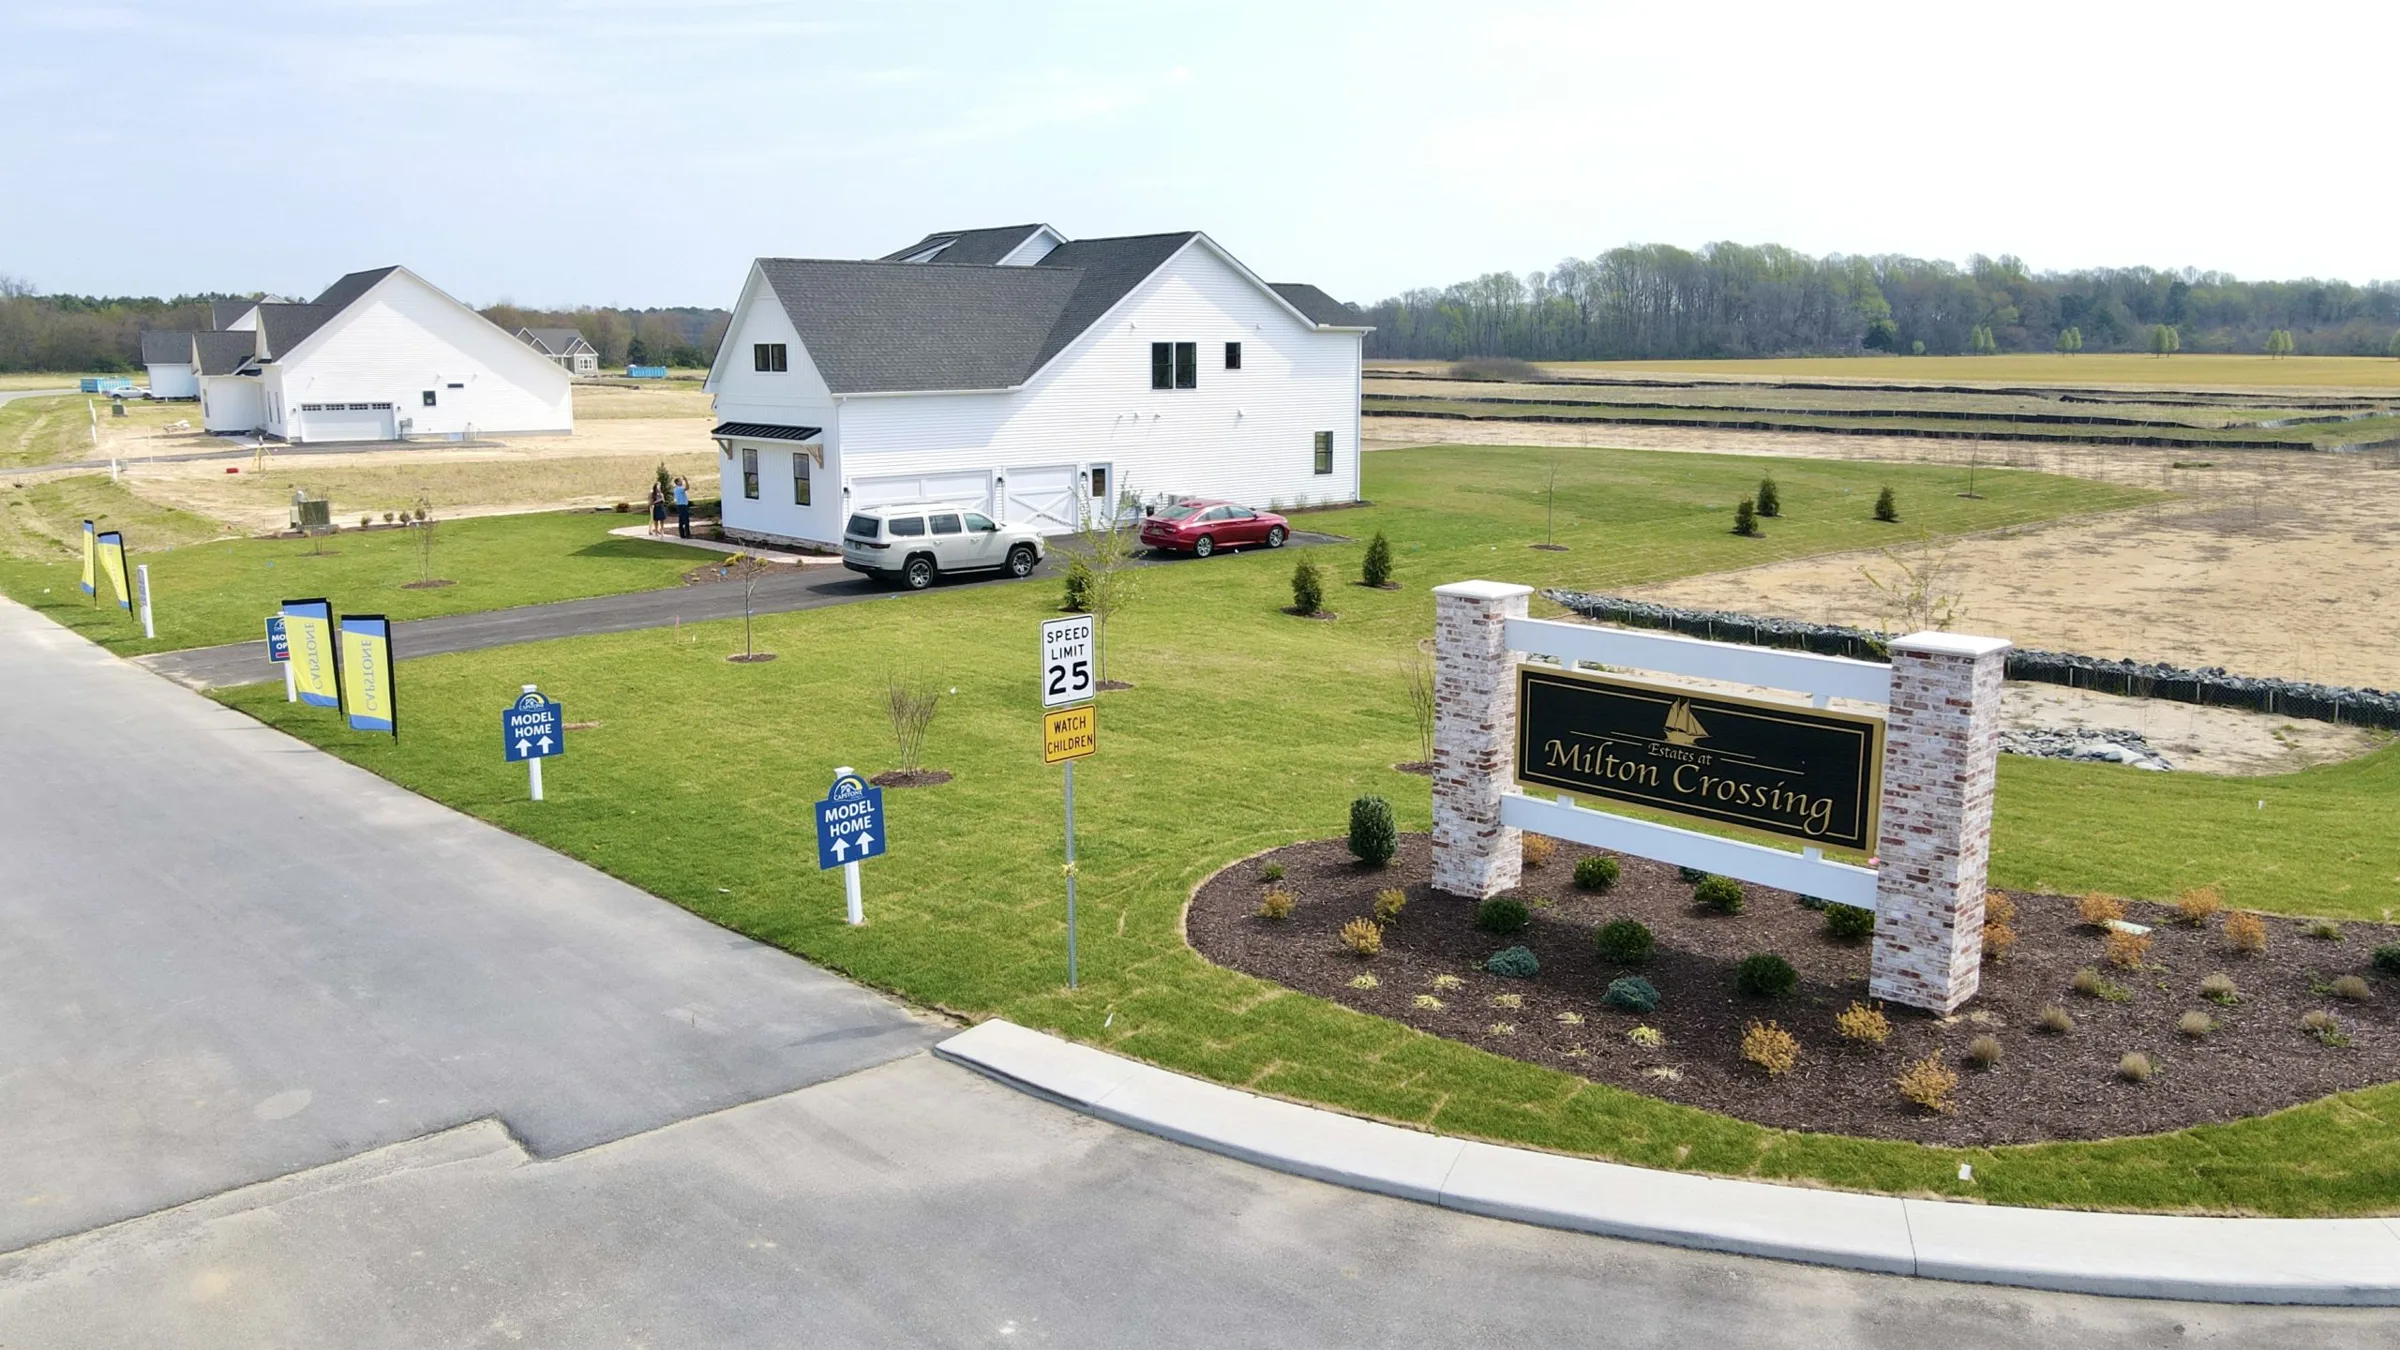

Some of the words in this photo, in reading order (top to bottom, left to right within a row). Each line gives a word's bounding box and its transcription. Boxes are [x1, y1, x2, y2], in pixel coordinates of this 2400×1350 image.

[1047, 626, 1089, 644] SPEED
[1051, 644, 1085, 660] LIMIT
[1048, 660, 1090, 696] 25
[511, 711, 555, 727] MODEL
[1053, 716, 1086, 734] WATCH
[514, 724, 552, 738] HOME
[1047, 734, 1093, 755] CHILDREN
[1648, 743, 1694, 762] Estates
[1697, 755, 1713, 765] at
[1544, 739, 1660, 787] Milton
[1671, 763, 1834, 836] Crossing
[825, 799, 875, 823] MODEL
[830, 815, 872, 838] HOME
